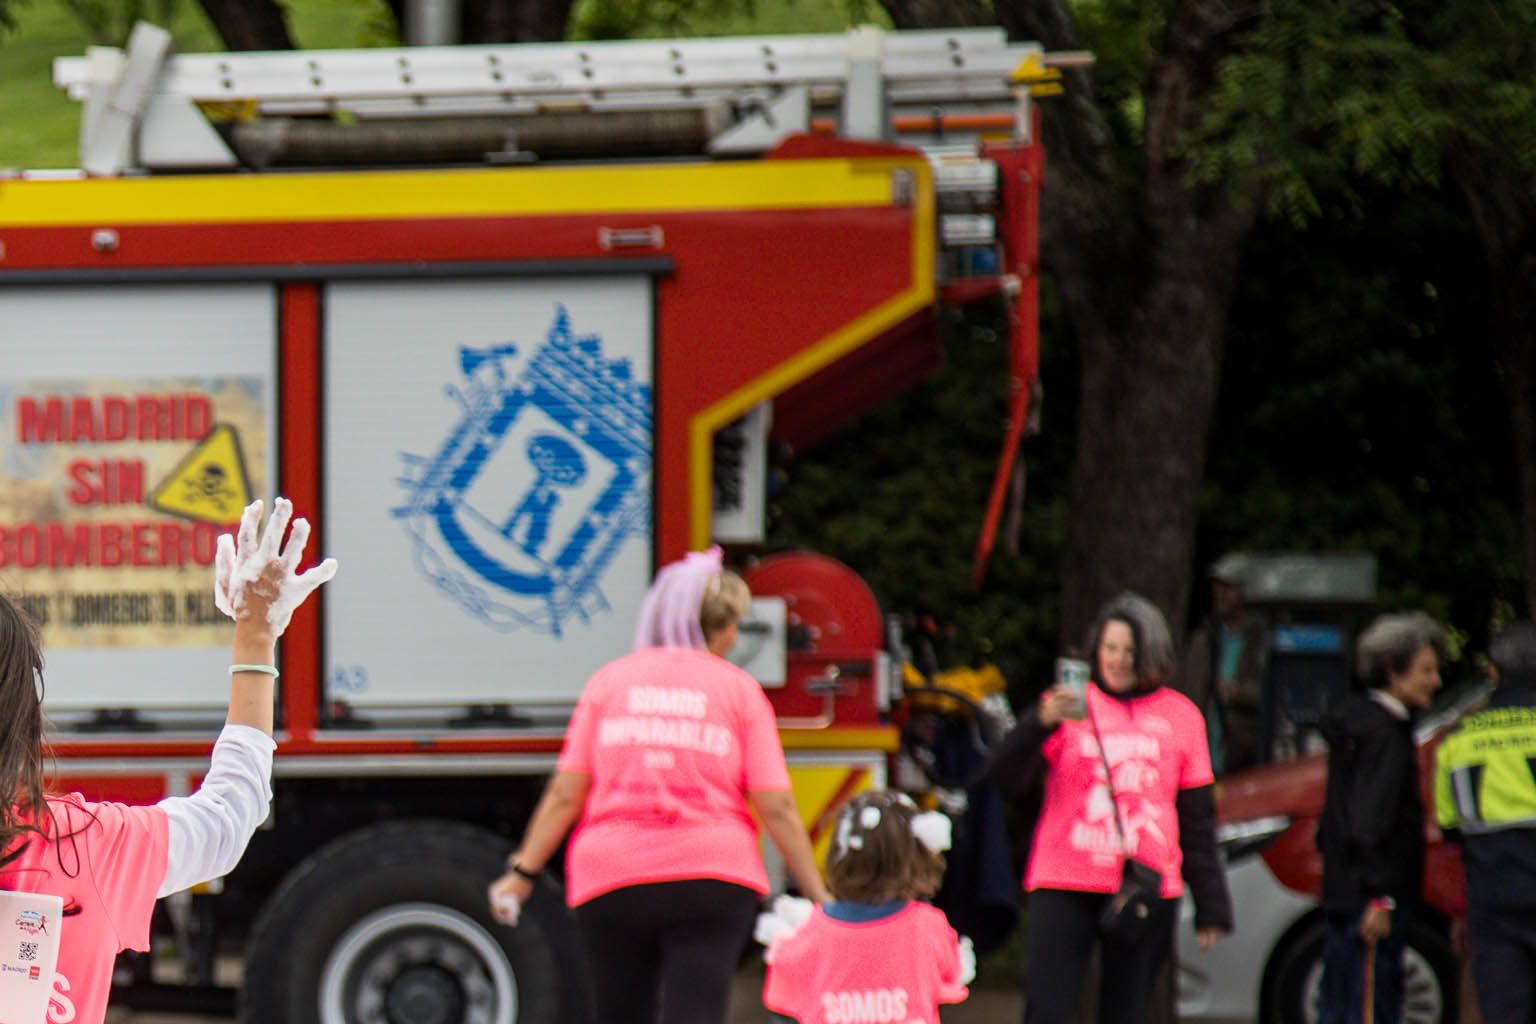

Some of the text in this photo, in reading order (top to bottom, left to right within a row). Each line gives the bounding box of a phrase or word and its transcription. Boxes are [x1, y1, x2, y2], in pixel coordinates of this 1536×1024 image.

[16, 392, 212, 442] MADRID
[66, 457, 144, 504] SIN
[822, 987, 908, 1024] SOMOS
